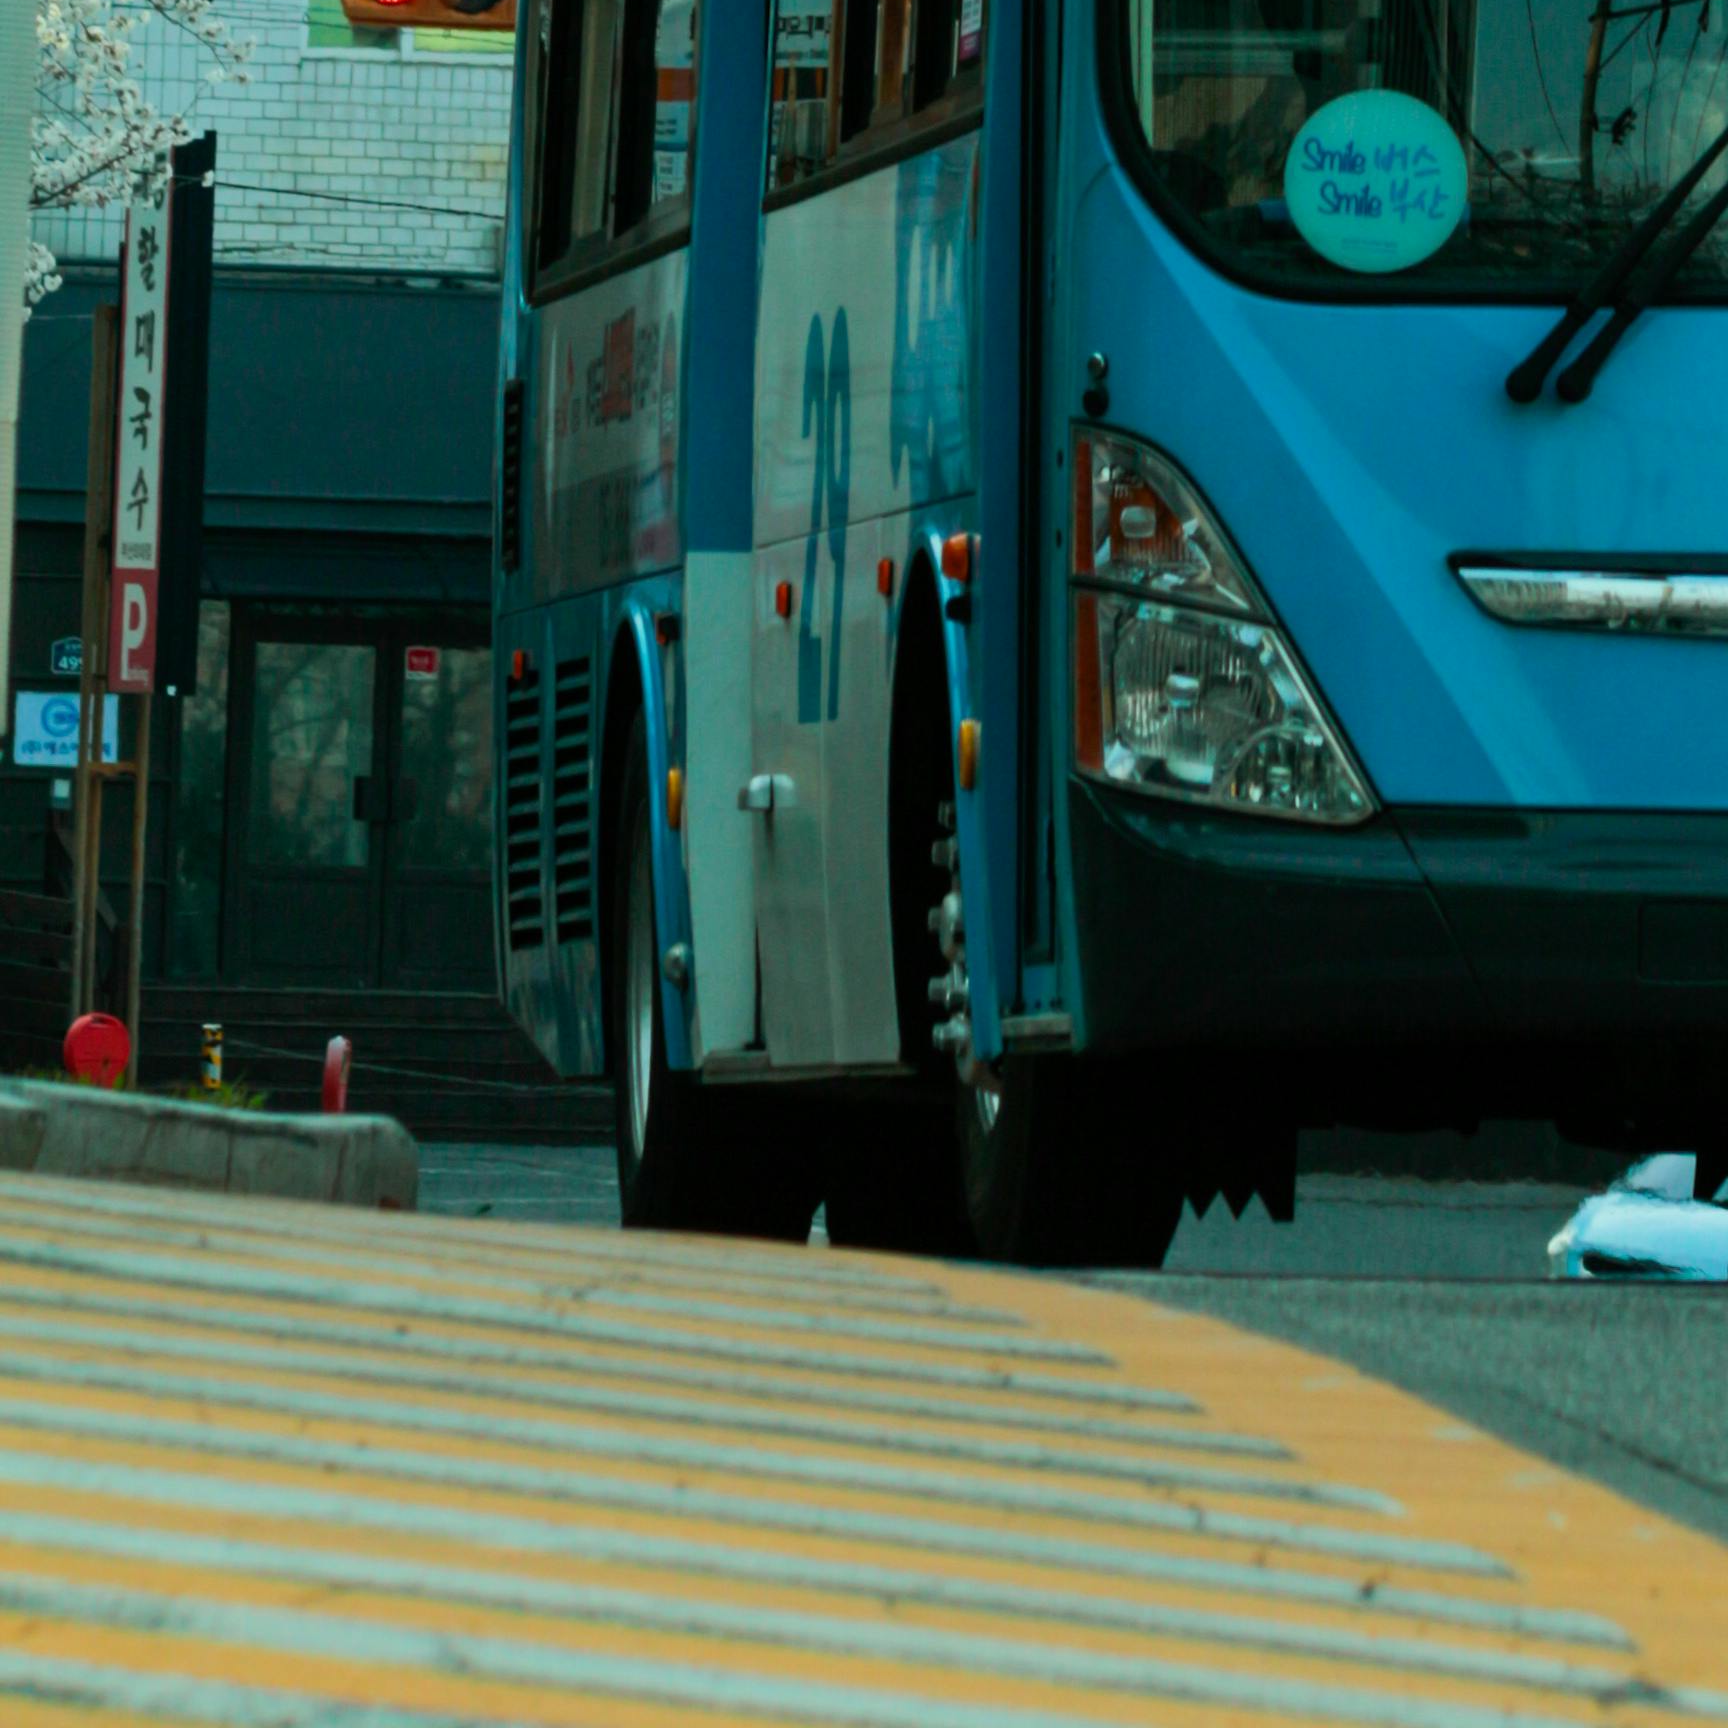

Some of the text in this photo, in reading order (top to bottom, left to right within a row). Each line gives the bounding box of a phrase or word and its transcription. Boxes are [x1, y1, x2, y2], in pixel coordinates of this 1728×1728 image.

[1302, 136, 1441, 178] Smile 버스
[1318, 180, 1383, 218] Smile
[797, 304, 852, 724] 29
